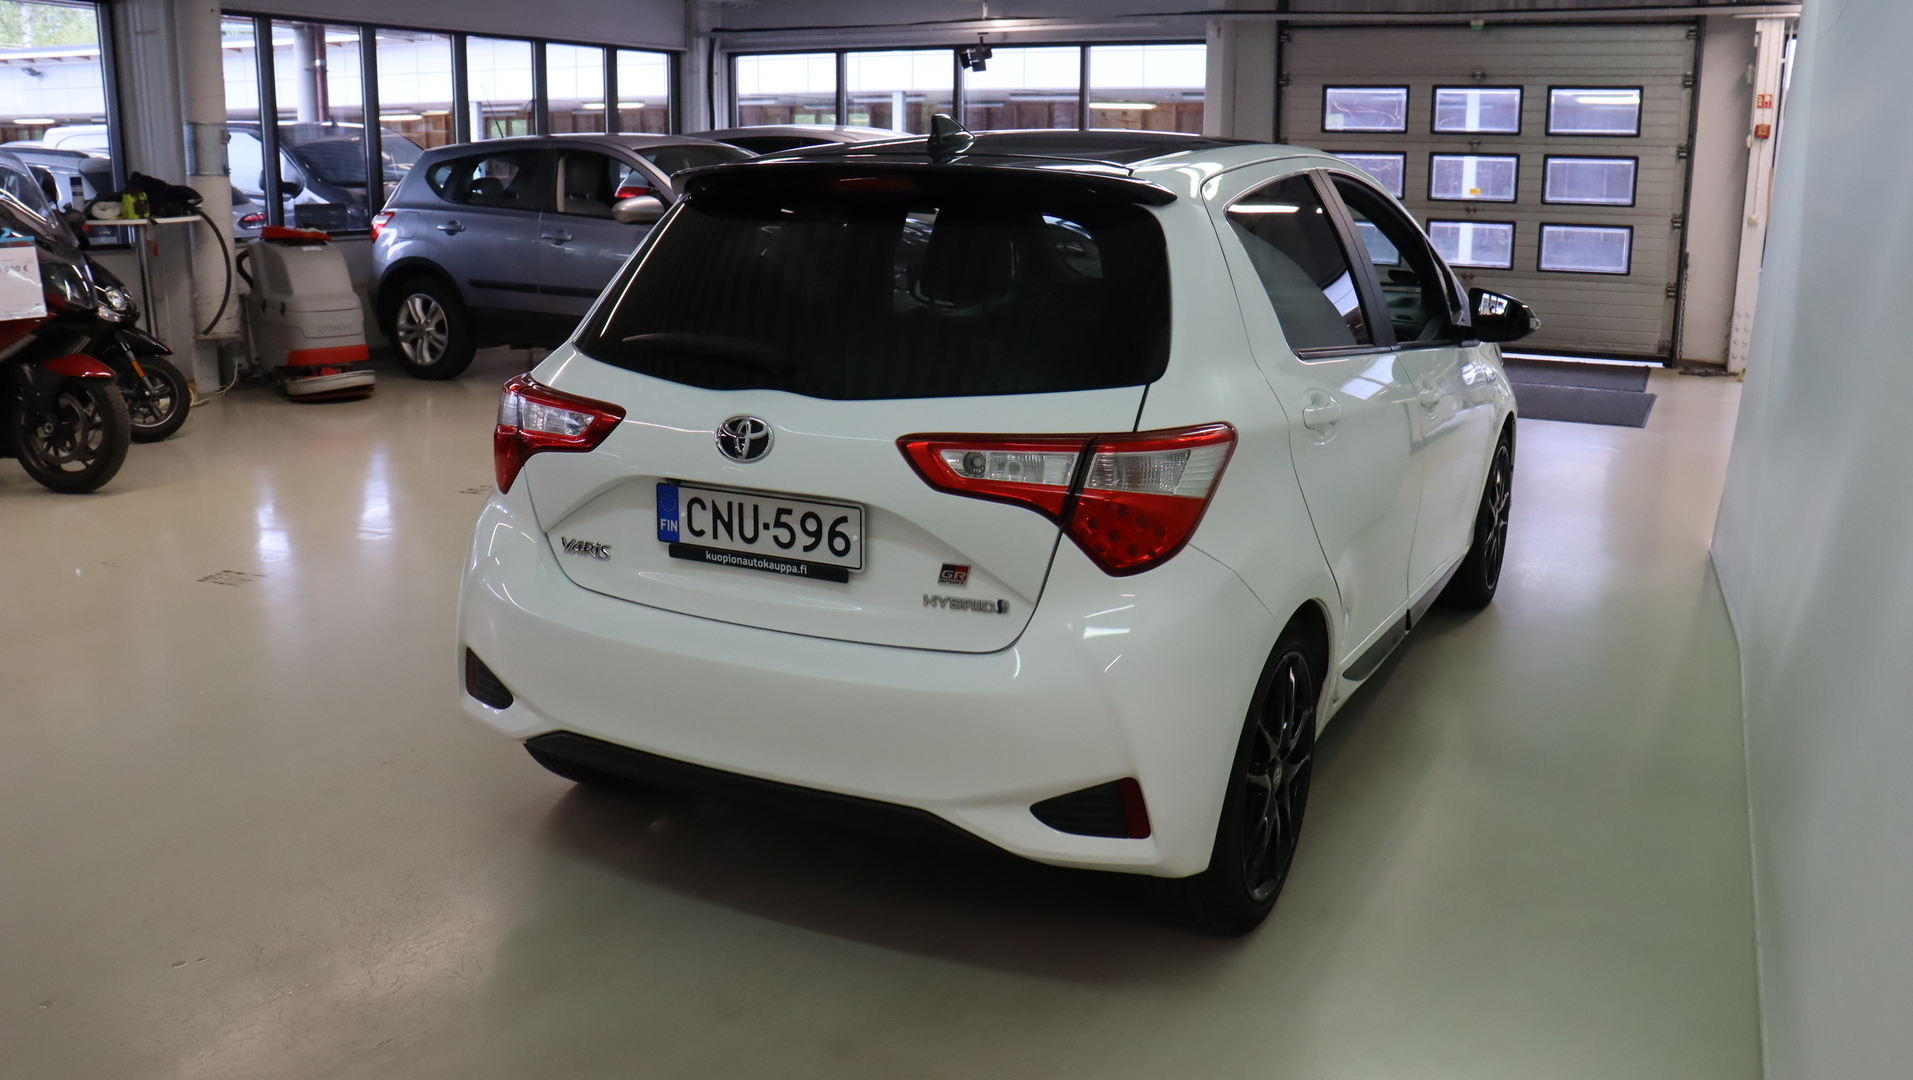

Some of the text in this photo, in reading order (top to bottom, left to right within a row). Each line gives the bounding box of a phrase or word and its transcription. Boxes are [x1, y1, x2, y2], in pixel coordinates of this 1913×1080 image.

[660, 518, 678, 533] FIN
[705, 550, 808, 575] kuopionautokauppa.fi
[940, 570, 967, 580] GR
[923, 594, 996, 613] HYBRID
